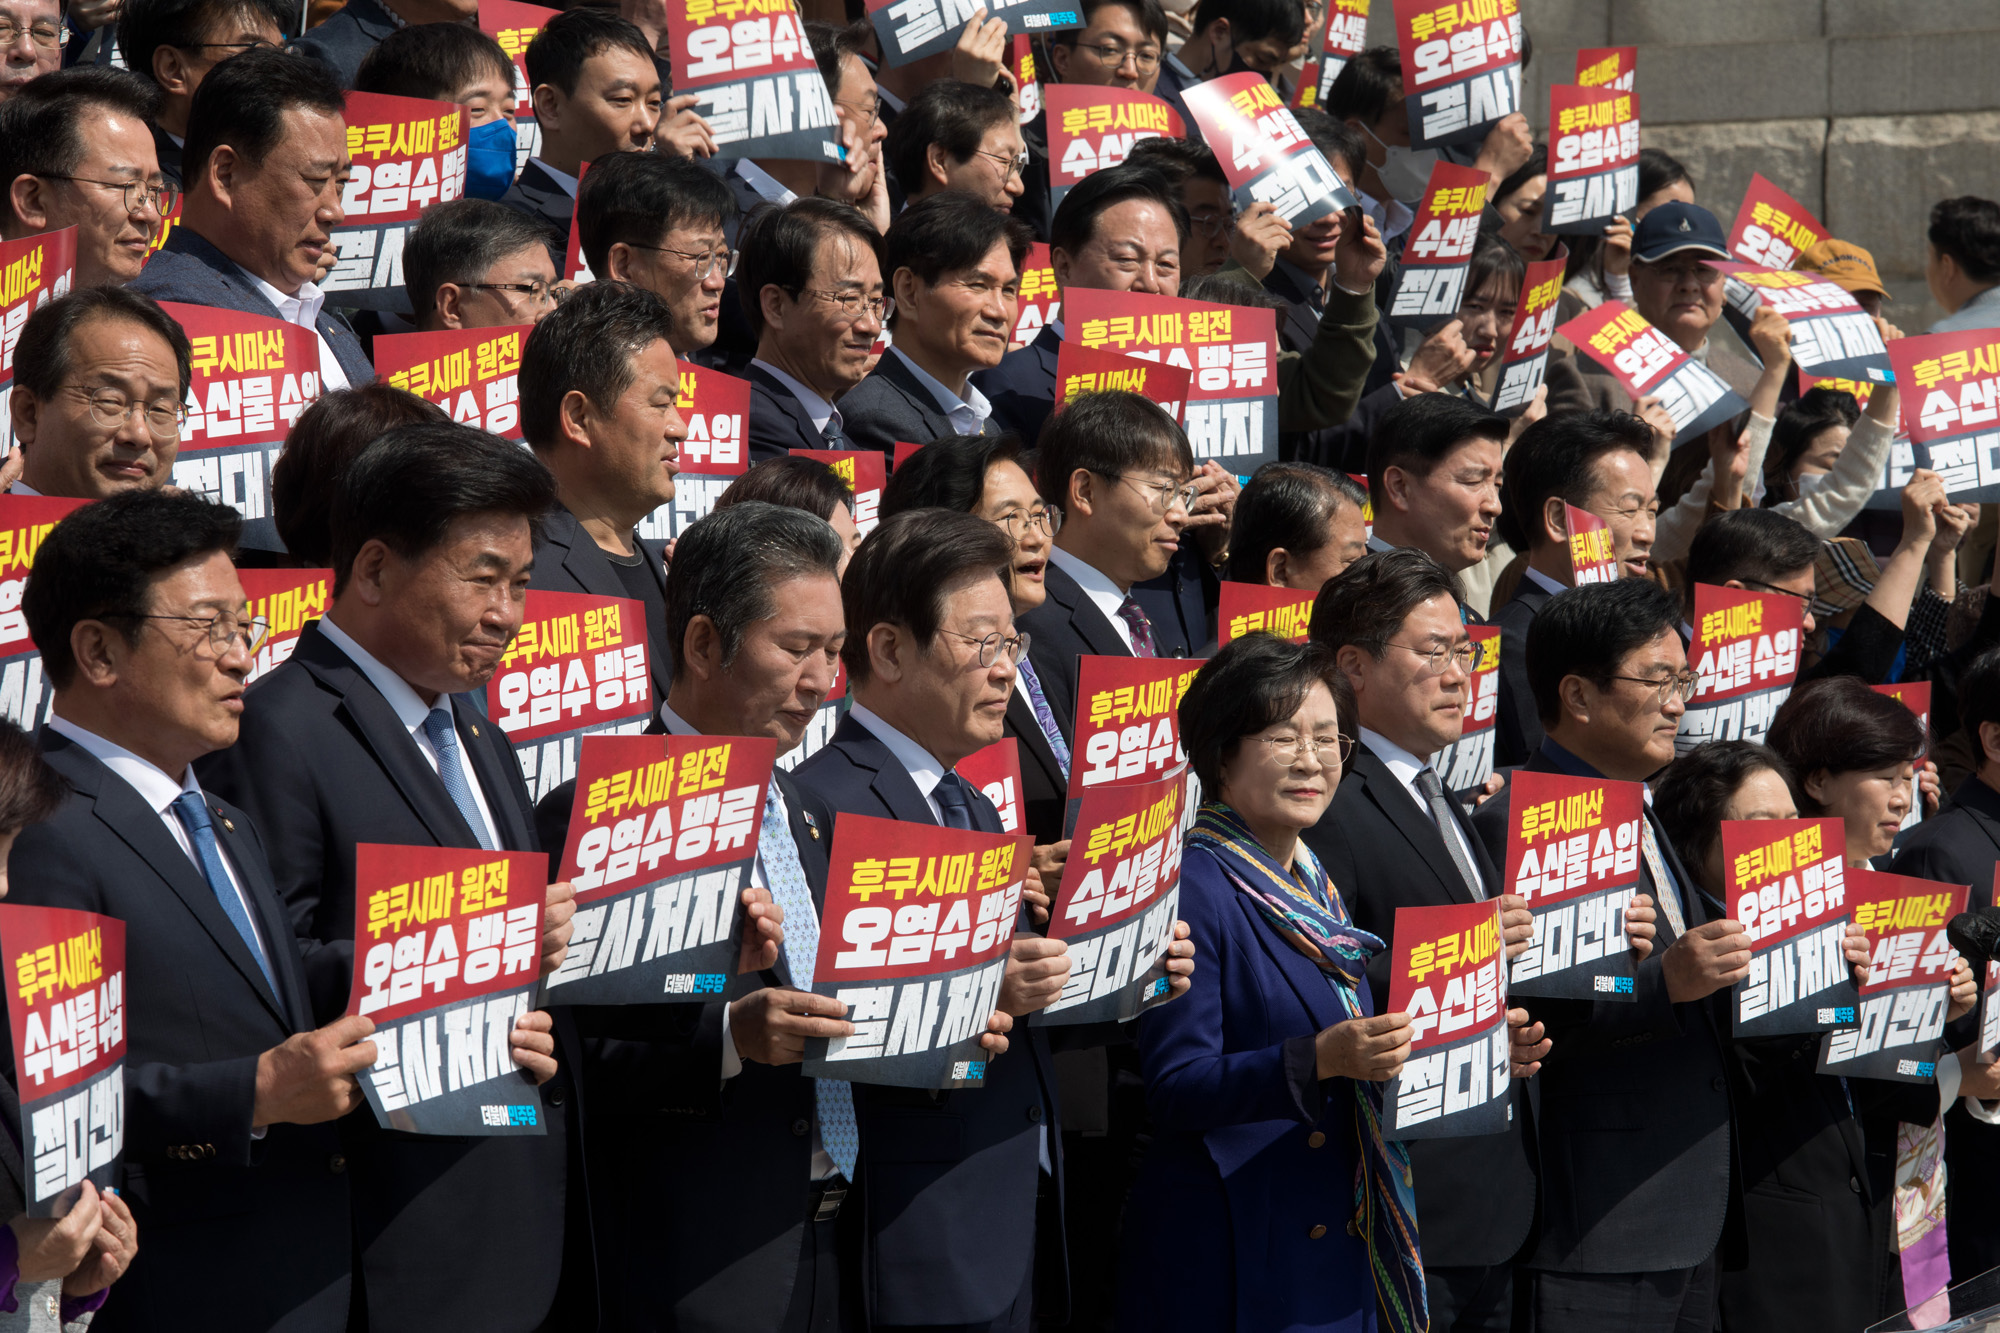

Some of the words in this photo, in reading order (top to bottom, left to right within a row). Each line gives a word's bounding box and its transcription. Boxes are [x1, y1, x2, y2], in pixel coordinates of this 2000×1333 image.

[1023, 11, 1077, 28] 더불어민주당
[1414, 20, 1511, 85] 오염수
[694, 76, 794, 145] 결사
[1062, 103, 1169, 136] 후쿠시마산
[1421, 70, 1511, 140] 결사
[1558, 100, 1613, 134] 후쿠시마
[1615, 95, 1631, 124] 원전
[346, 118, 435, 161] 후쿠시마
[438, 110, 460, 151] 원전
[1061, 132, 1160, 178] 수산
[1554, 126, 1619, 173] 오염수
[440, 144, 466, 202] 방류
[1551, 173, 1614, 226] 결사
[1413, 214, 1480, 257] 수산물
[1736, 225, 1796, 270] 오염
[1390, 267, 1463, 316] 절대
[189, 329, 284, 377] 쿠시마산
[476, 332, 520, 381] 원전
[1082, 312, 1183, 349] 후쿠시마
[1188, 310, 1232, 343] 원전
[1198, 342, 1267, 390] 방류
[1913, 343, 2000, 389] 후쿠시
[1185, 401, 1264, 458] 저지
[1920, 376, 2000, 432] 수산
[684, 413, 741, 464] 수입
[246, 580, 328, 637] 시마산
[584, 604, 622, 651] 원전
[1701, 599, 1763, 647] 후쿠시마산
[499, 658, 591, 732] 오염수
[595, 643, 649, 711] 방류
[1695, 639, 1751, 696] 수산물
[1753, 628, 1798, 681] 수입
[1090, 677, 1173, 728] 후쿠시마
[1082, 717, 1174, 786] 오염수
[584, 757, 675, 824] 후쿠시마
[677, 743, 731, 796] 원전
[570, 806, 673, 893] 오염수
[675, 785, 760, 861] 방류
[1084, 783, 1178, 865] 후쿠시마산
[1520, 788, 1604, 844] 후쿠시마산
[849, 852, 975, 902] 후쿠시마
[976, 843, 1016, 891] 원전
[1065, 838, 1164, 926] 수산물
[1515, 833, 1589, 904] 수산물
[1591, 819, 1639, 881] 수입
[1734, 836, 1793, 890] 후쿠시마
[1793, 824, 1823, 867] 원전
[367, 871, 455, 939] 후쿠시마
[459, 859, 509, 915] 원전
[546, 892, 647, 989] 결사
[641, 867, 741, 962] 저지
[834, 899, 970, 969] 오염수
[971, 880, 1023, 953] 방류
[1737, 875, 1802, 943] 오염수
[1802, 855, 1845, 918] 방류
[1855, 893, 1952, 935] 후쿠시마산
[358, 924, 460, 1016] 오염수
[463, 903, 539, 984] 방류
[1408, 909, 1500, 982] 후쿠시마산
[1511, 905, 1575, 984] 절대
[1575, 887, 1637, 965] 반대
[1866, 932, 1925, 986] 산물
[1919, 929, 1960, 975] 수
[16, 926, 102, 1006] 후쿠시마산
[664, 974, 726, 994] 더불어민주당
[1043, 919, 1140, 1014] 절대
[1594, 975, 1634, 994] 더불어민주당
[1740, 943, 1796, 1023] 결사
[1797, 920, 1850, 1000] 저지
[24, 989, 97, 1086] 수산물
[98, 971, 123, 1054] 수입
[825, 980, 942, 1062] 결사
[936, 958, 1005, 1049] 저지
[1404, 960, 1498, 1042] 수산물
[1883, 985, 1950, 1049] 반대
[362, 1016, 443, 1112] 결사
[444, 992, 530, 1092] 저지
[1396, 1037, 1488, 1130] 절대
[31, 1088, 88, 1202] 절대
[89, 1064, 124, 1174] 반대
[480, 1105, 537, 1126] 더불어민주당
